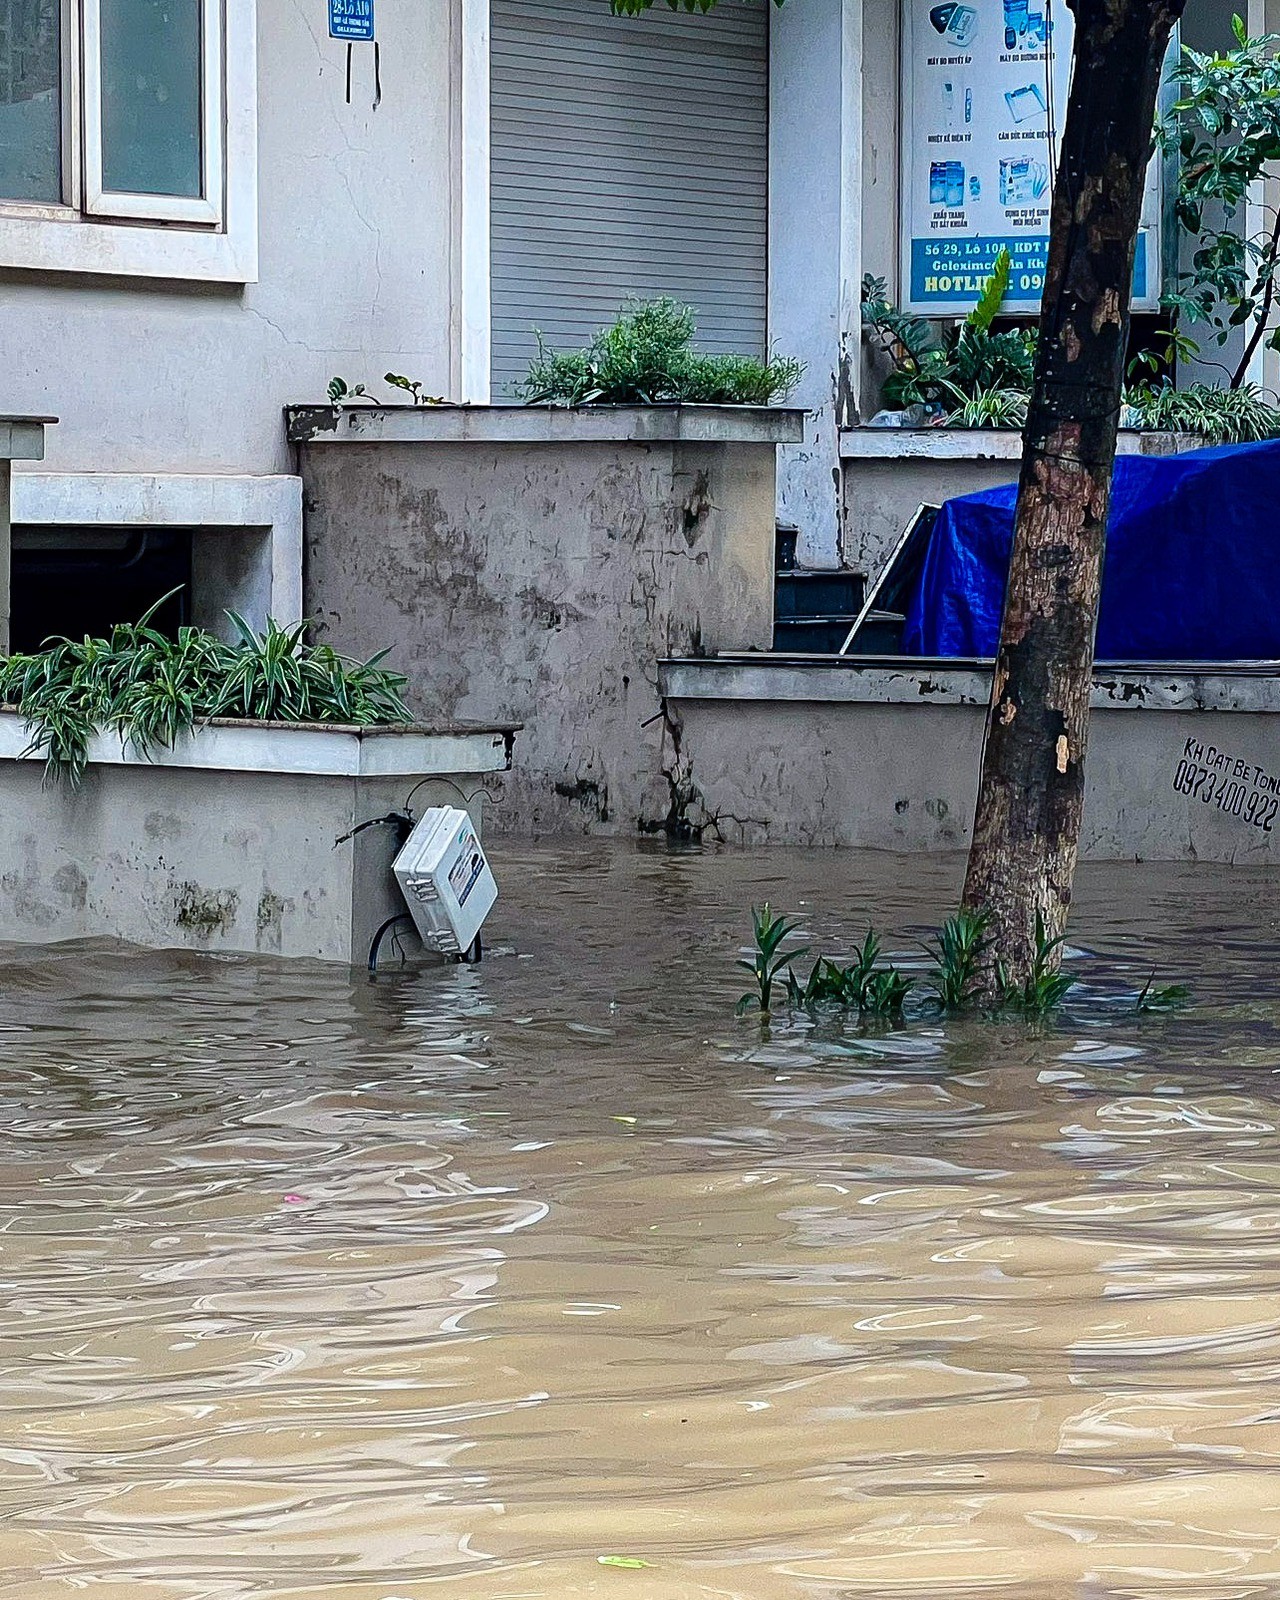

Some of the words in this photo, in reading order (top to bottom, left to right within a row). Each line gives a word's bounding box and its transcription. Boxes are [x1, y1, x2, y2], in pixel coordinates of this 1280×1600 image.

[925, 243, 940, 255] Số
[965, 243, 981, 254] Lô
[1027, 258, 1047, 269] Kh
[1020, 273, 1046, 290] 09
[1184, 737, 1204, 761] KH
[1205, 746, 1233, 773] CAT
